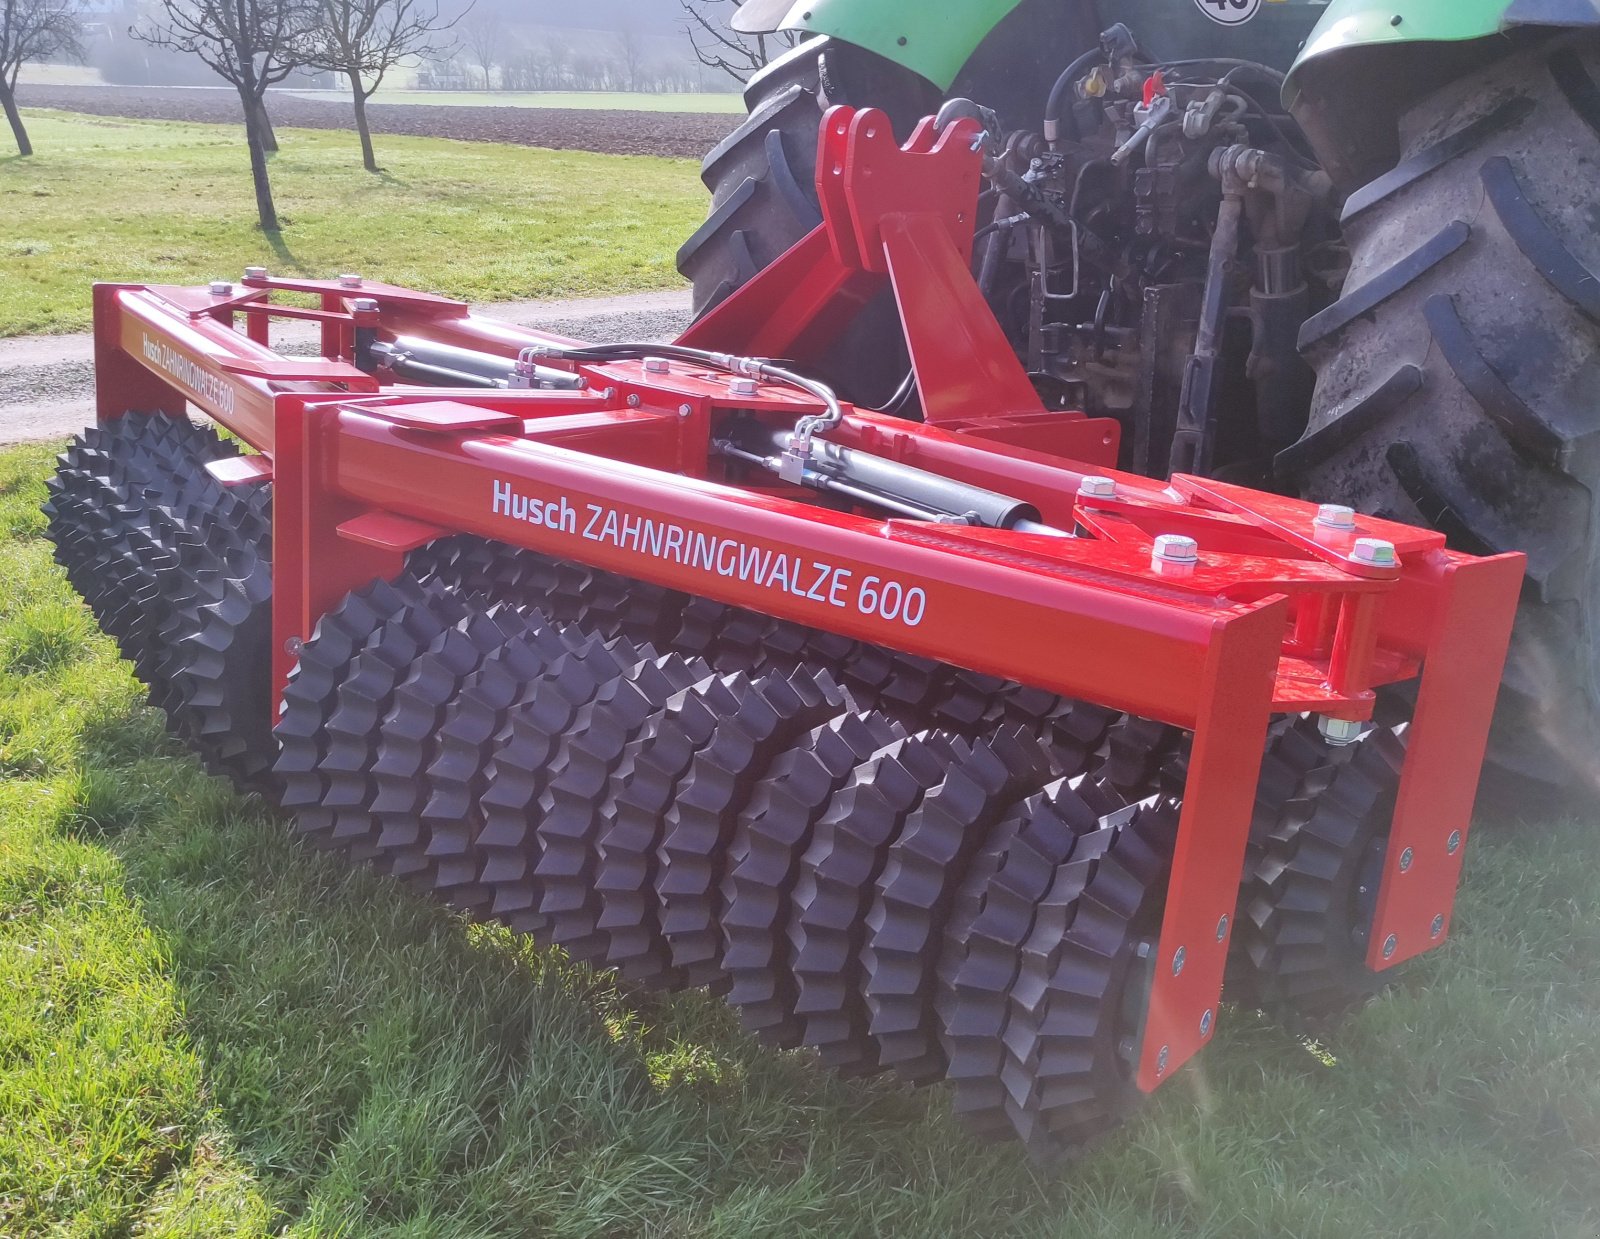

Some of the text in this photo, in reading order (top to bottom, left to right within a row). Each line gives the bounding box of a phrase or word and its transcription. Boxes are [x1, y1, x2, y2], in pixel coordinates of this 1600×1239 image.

[143, 332, 234, 415] Husch ZAHNRINGWALZE 600
[493, 479, 926, 626] Husch ZAHNRINGWALZE 600
